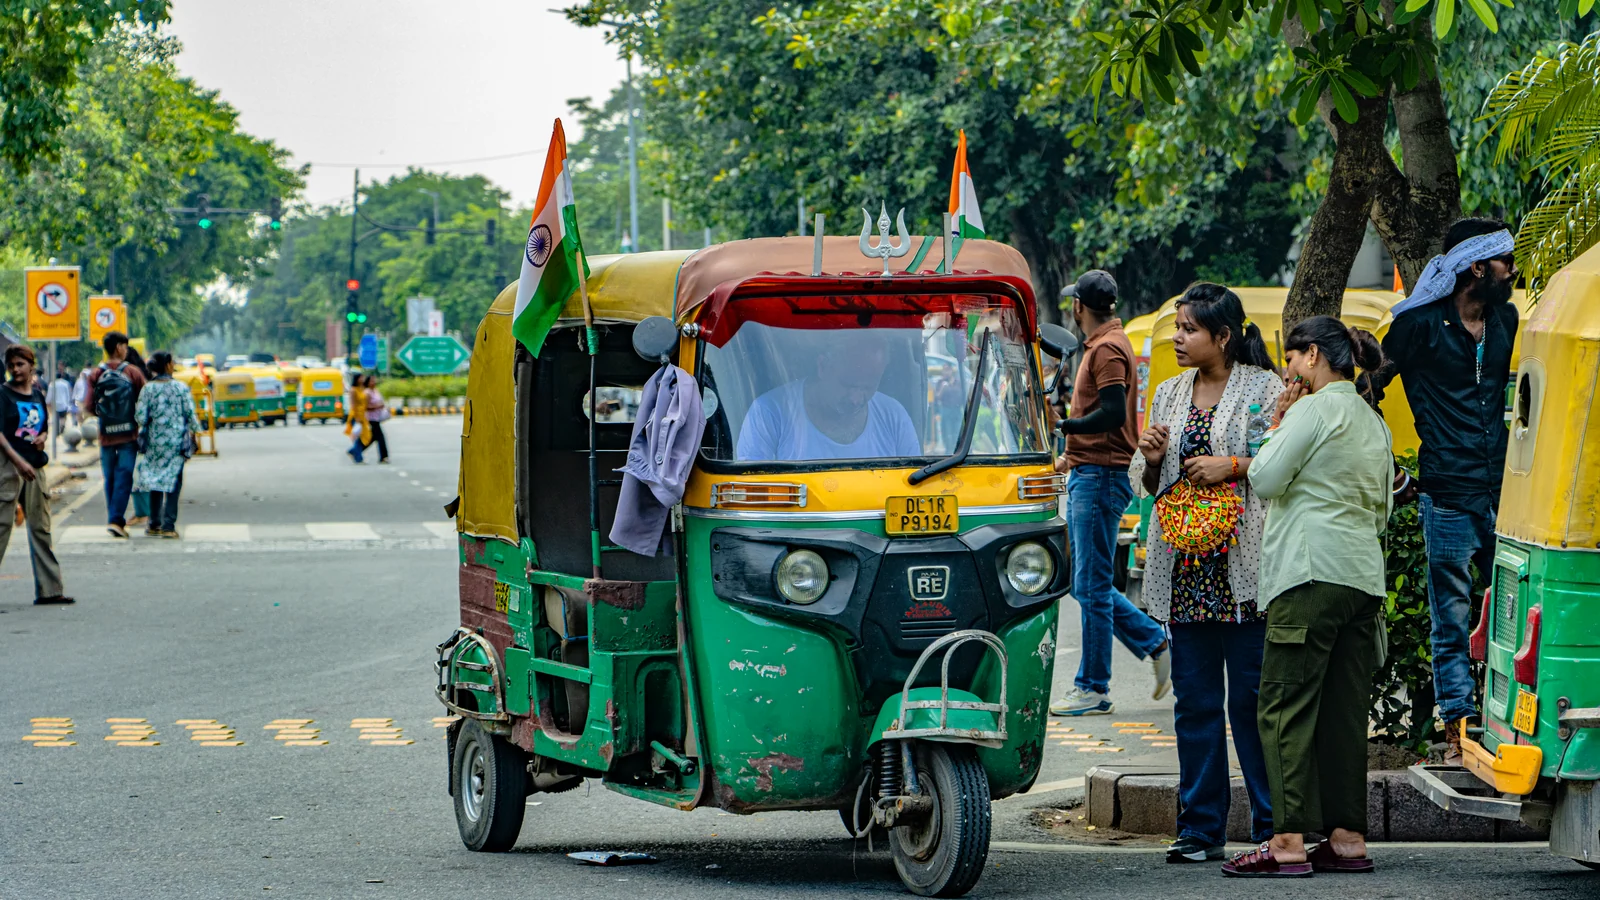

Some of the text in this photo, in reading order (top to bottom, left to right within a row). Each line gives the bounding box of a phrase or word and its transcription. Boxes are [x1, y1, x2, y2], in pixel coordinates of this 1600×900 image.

[906, 497, 945, 514] DL1R
[901, 513, 951, 531] P9194
[917, 578, 943, 594] RE
